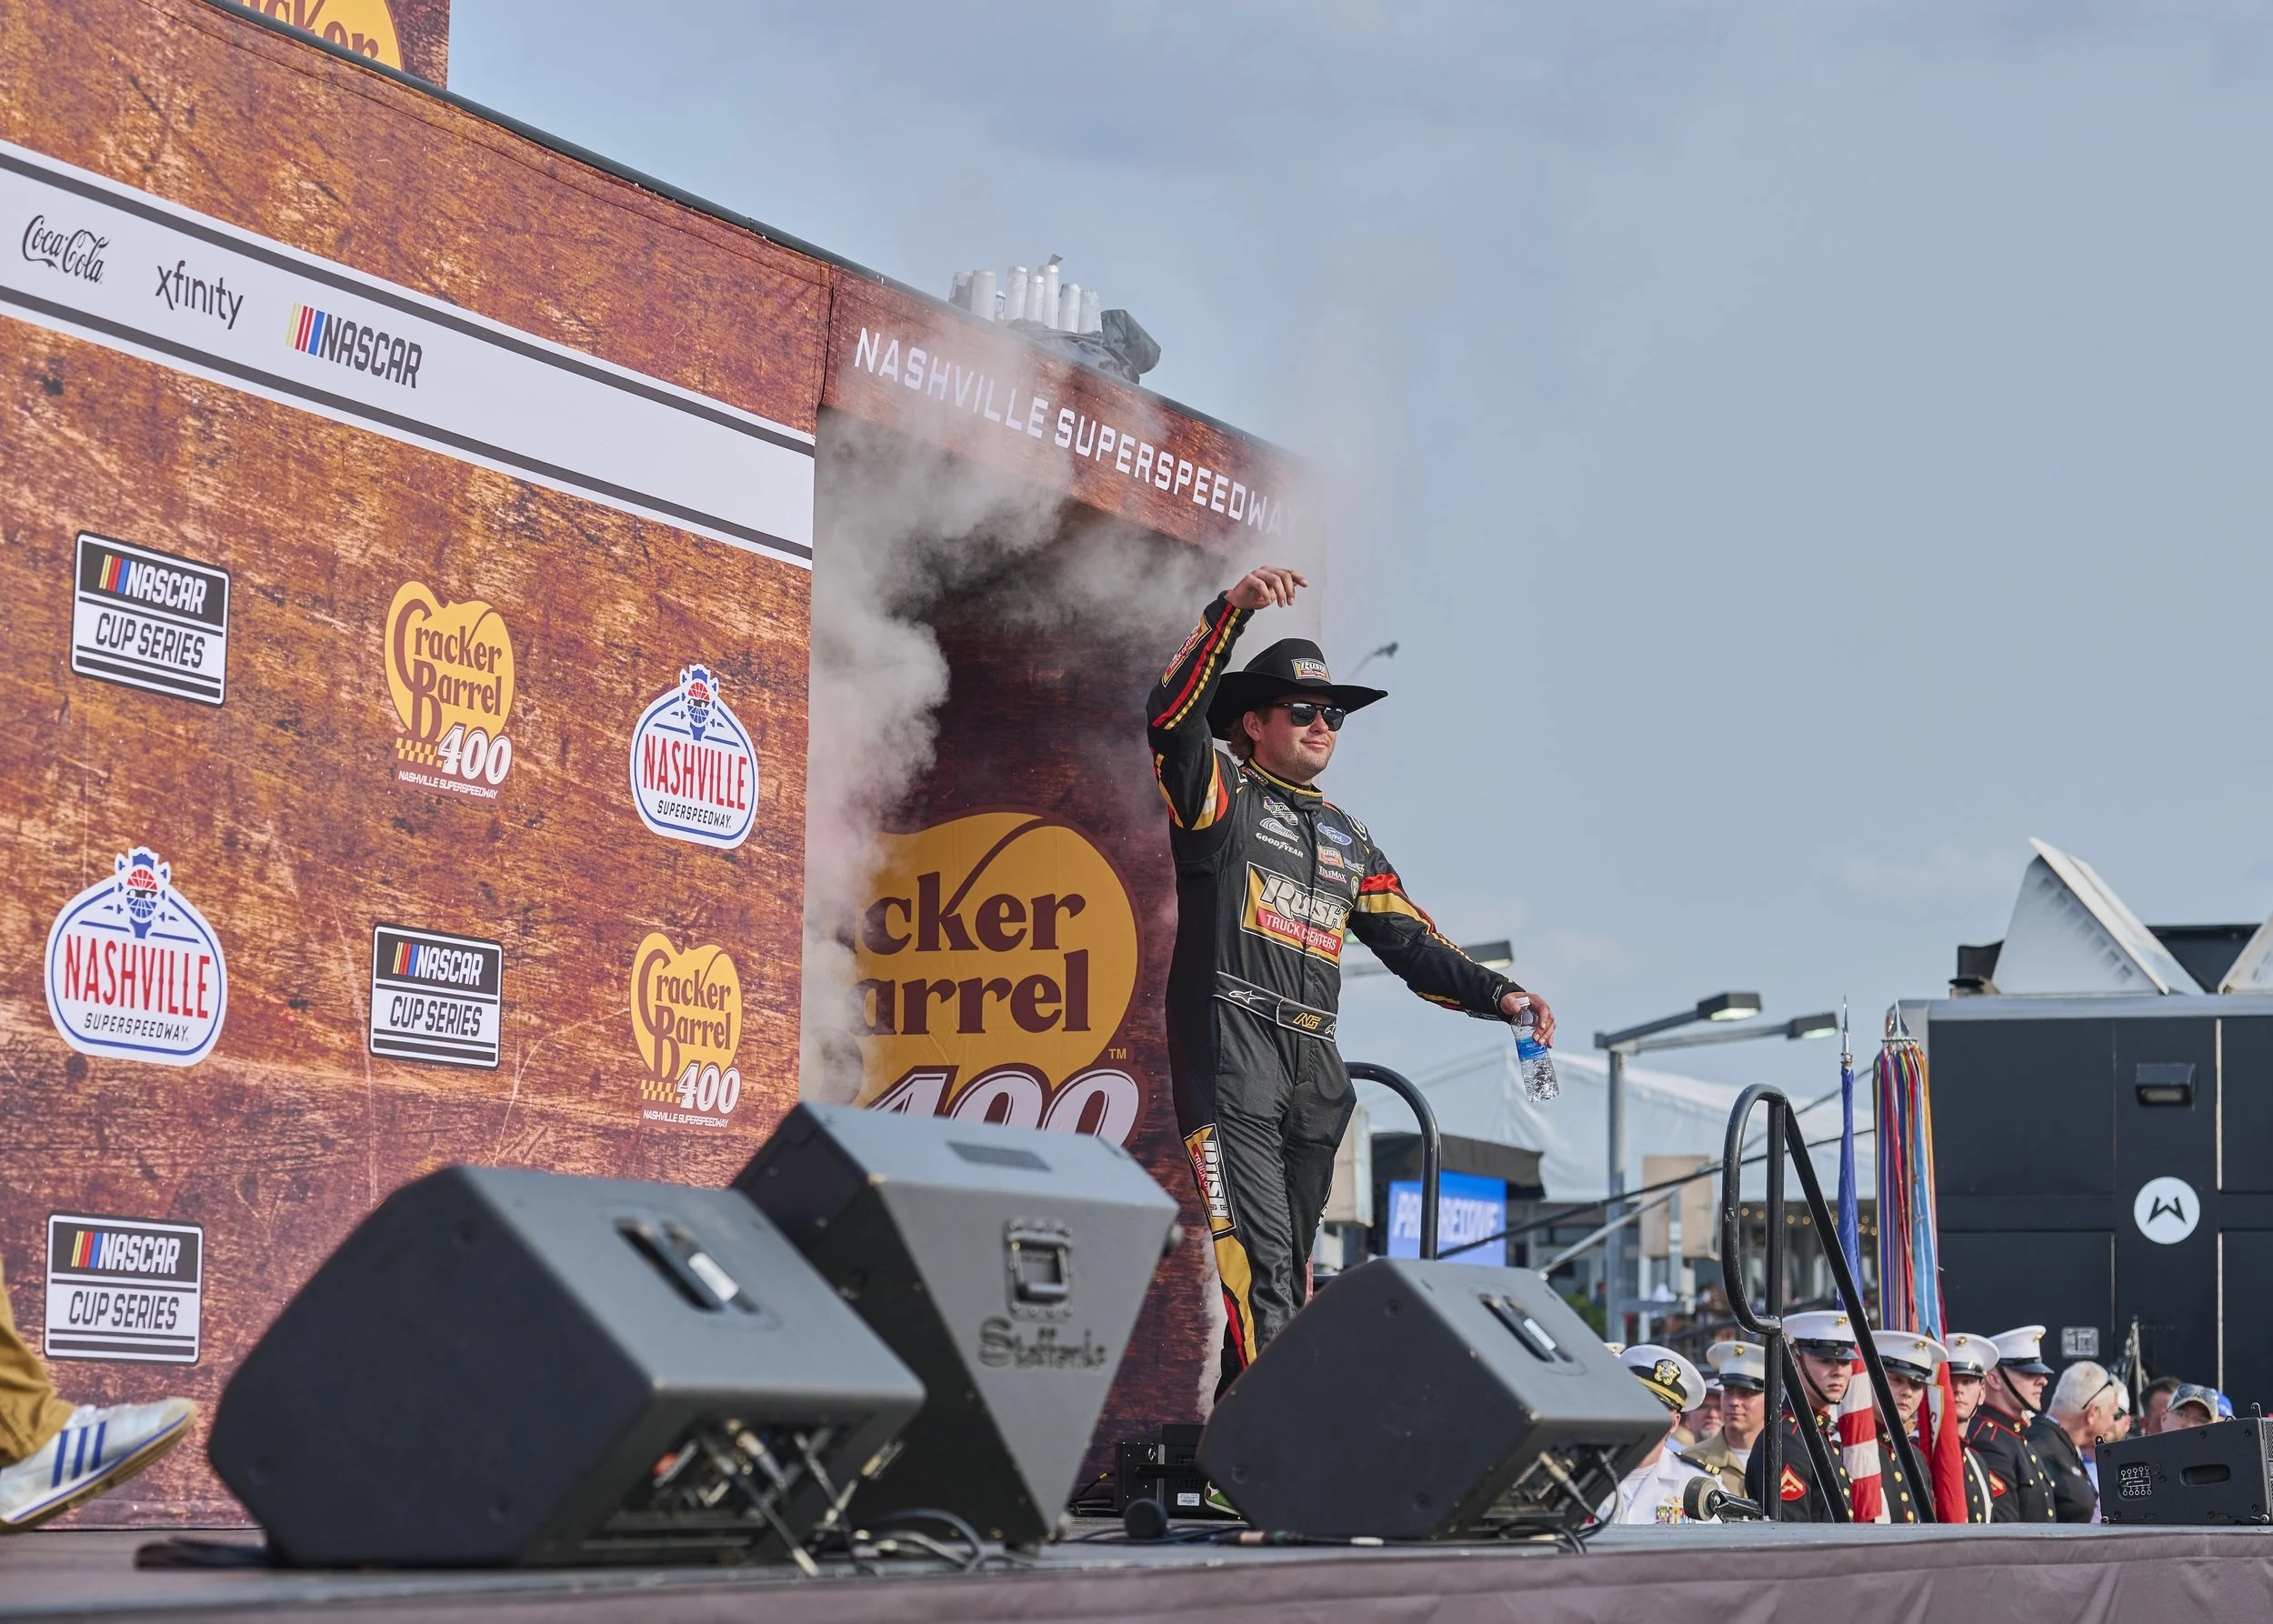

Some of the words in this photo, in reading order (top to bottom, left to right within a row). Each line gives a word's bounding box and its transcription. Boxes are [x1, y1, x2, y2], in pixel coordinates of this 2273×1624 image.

[22, 215, 110, 284] Coca-Cola
[155, 259, 244, 329] xfinity
[318, 313, 424, 388] NASCAR
[854, 326, 1049, 439] NASHVILLE
[125, 560, 207, 614] NASCAR
[95, 612, 137, 651] CUP
[137, 623, 205, 669] SERIES
[393, 598, 503, 693] Cracker
[409, 658, 502, 743] Barrel
[437, 725, 512, 786] 400
[643, 733, 747, 811] NASHVILLE
[398, 769, 439, 788] NASHVILLE
[438, 777, 497, 800] SUPERSPEEDWAY
[656, 799, 731, 828] SUPERSPEEDWAY
[1256, 832, 1304, 858] GOODYEAR
[1266, 914, 1300, 937] TRUCK
[1301, 927, 1337, 951] CENTERS
[64, 933, 211, 1019] NASHVILLE
[415, 945, 484, 987] NASCAR
[637, 948, 731, 1037] Cracker
[844, 948, 1091, 1037] arrel
[84, 1012, 189, 1042] SUPERSPEEDWAY
[389, 995, 425, 1029] CUP
[426, 1000, 483, 1038] SERIES
[653, 1004, 731, 1080] Barrel
[676, 1062, 741, 1115] 400
[643, 1109, 678, 1123] NASHVILLE
[677, 1113, 729, 1128] SUPERSPEEDWAY
[1194, 1152, 1208, 1181] TRUCK
[97, 1232, 181, 1275] NASCAR
[69, 1290, 110, 1327] CUP
[110, 1293, 180, 1330] SERIES
